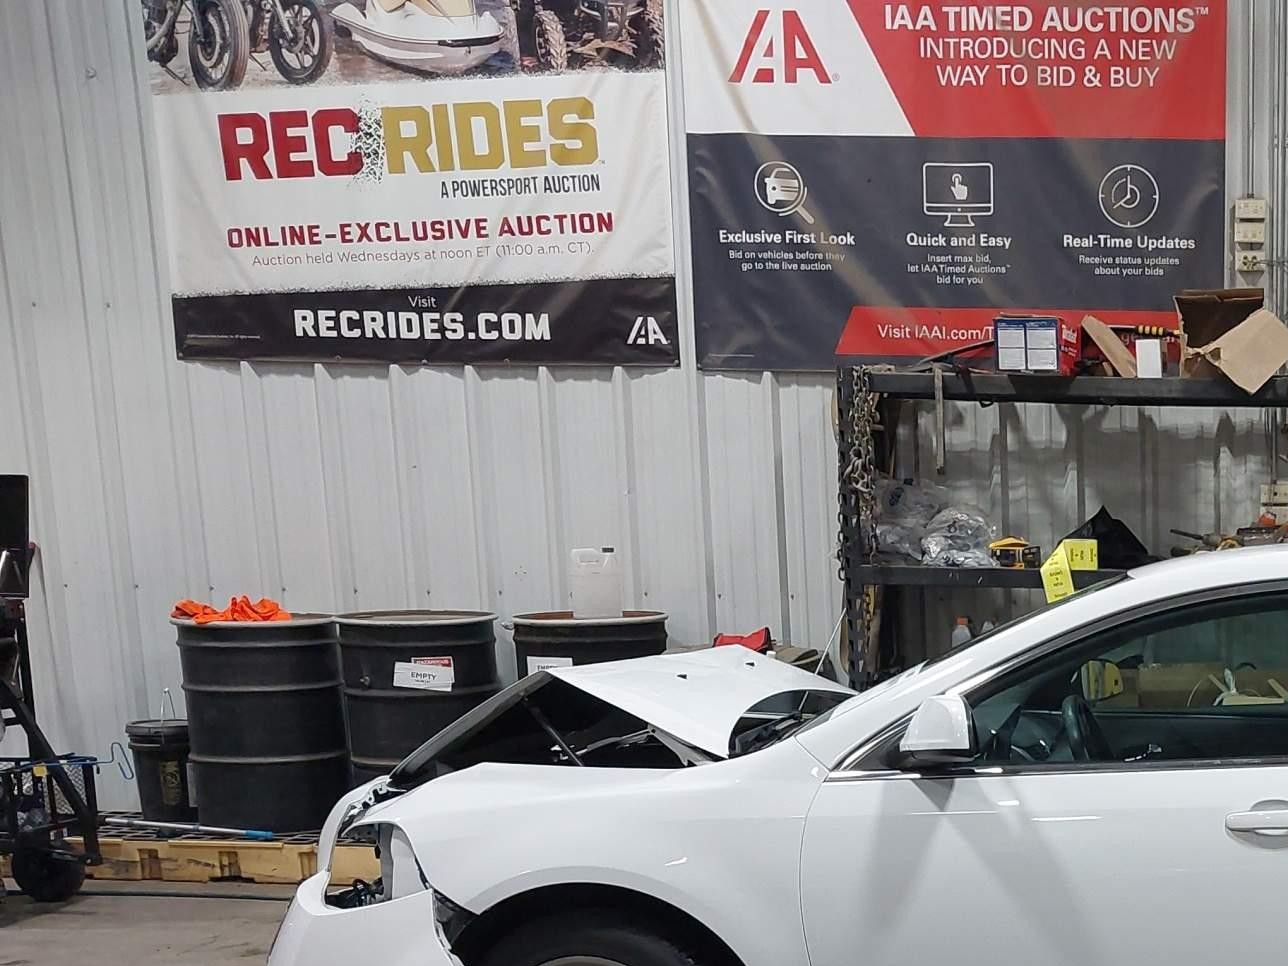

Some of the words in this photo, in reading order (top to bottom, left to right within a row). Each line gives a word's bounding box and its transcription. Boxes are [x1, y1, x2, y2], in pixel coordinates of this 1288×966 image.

[884, 4, 937, 31] IAA
[942, 5, 1033, 32] TIMED
[919, 37, 1086, 60] INTRODUCING
[1093, 38, 1112, 60] A
[1120, 39, 1177, 60] NEW
[936, 64, 990, 86] WAY
[996, 64, 1028, 86] TO
[1037, 65, 1076, 87] BID
[1083, 66, 1102, 87] &
[1109, 66, 1160, 87] BUY
[217, 108, 365, 182] REC
[441, 181, 449, 199] A
[451, 176, 539, 198] POWERSPORT
[543, 174, 600, 194] AUCTION
[226, 218, 489, 248] ONLINE-EXCLUSIVE
[498, 212, 614, 236] AUCTION
[718, 229, 782, 244] Exclusive
[785, 230, 817, 244] First
[820, 231, 856, 245] Look
[906, 232, 947, 247] Quick
[950, 233, 976, 247] and
[979, 233, 1012, 250] Easy
[1063, 234, 1133, 248] Real-Time
[1136, 235, 1196, 251] Updates
[252, 254, 303, 267] Auction
[306, 252, 334, 265] held
[337, 250, 421, 264] Wednesdays
[424, 250, 437, 260] at
[440, 248, 473, 260] noon
[476, 246, 491, 258] ET
[495, 243, 533, 258] (11:00
[537, 244, 564, 255] a.m.
[728, 249, 743, 259] Bid
[744, 251, 756, 259] on
[757, 250, 794, 260] vehicles
[795, 250, 824, 260] before
[825, 251, 846, 262] they
[927, 253, 953, 263] Insert
[954, 255, 974, 263] max
[975, 253, 992, 264] bid,
[1078, 254, 1113, 264] Receive
[1114, 255, 1142, 265] status
[1143, 256, 1180, 266] updates
[741, 262, 753, 272] go
[754, 261, 764, 270] to
[765, 261, 780, 270] the
[782, 261, 798, 270] live
[799, 261, 832, 271] auction
[907, 263, 920, 273] let
[921, 264, 938, 273] IAA
[938, 263, 966, 273] Timed
[1094, 266, 1120, 275] about
[1121, 267, 1143, 277] your
[1144, 267, 1164, 276] bids
[936, 275, 951, 284] bid
[952, 275, 966, 284] for
[966, 276, 984, 286] you
[408, 295, 436, 308] Visit
[294, 309, 551, 341] RECRIDES.COM
[877, 324, 911, 339] Visit
[410, 671, 437, 681] EMPTY
